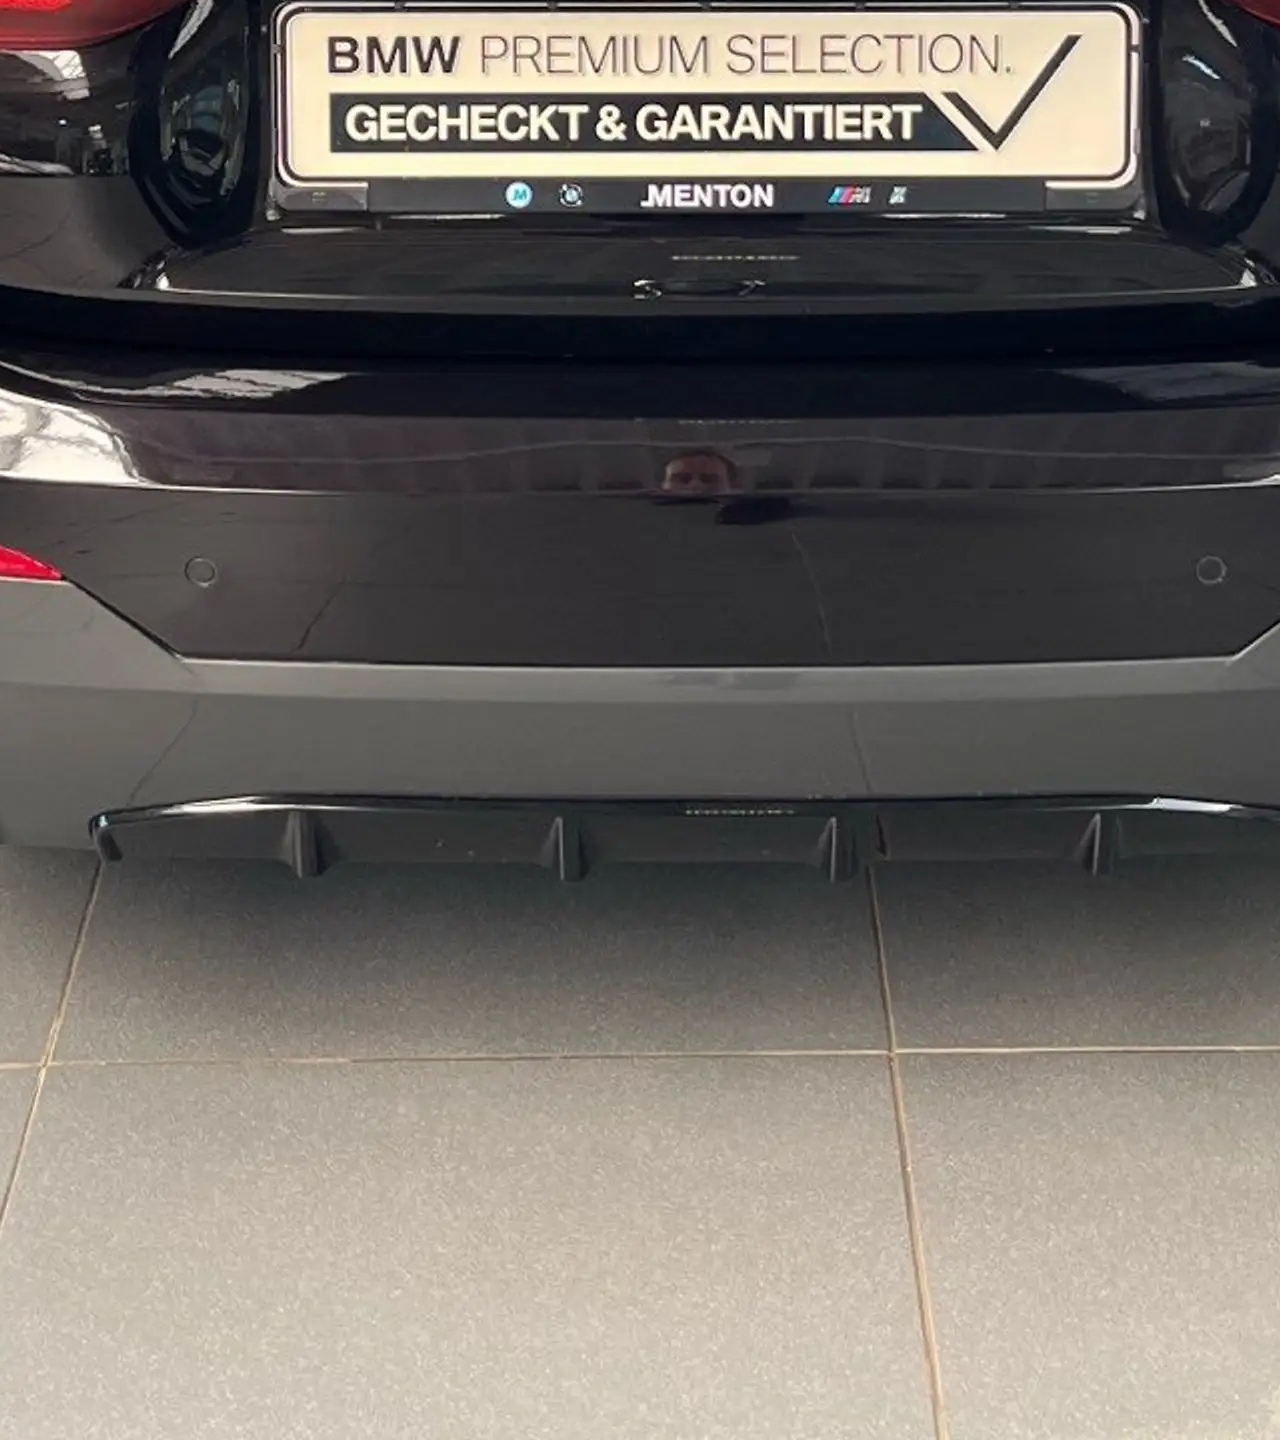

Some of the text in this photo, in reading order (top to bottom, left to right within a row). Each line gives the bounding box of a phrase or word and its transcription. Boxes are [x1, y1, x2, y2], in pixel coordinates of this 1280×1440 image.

[327, 33, 1012, 74] BMW PREMIUM SELECTION.
[345, 103, 924, 142] GECHECKT & GARANTIERT
[640, 183, 775, 208] MENTON
